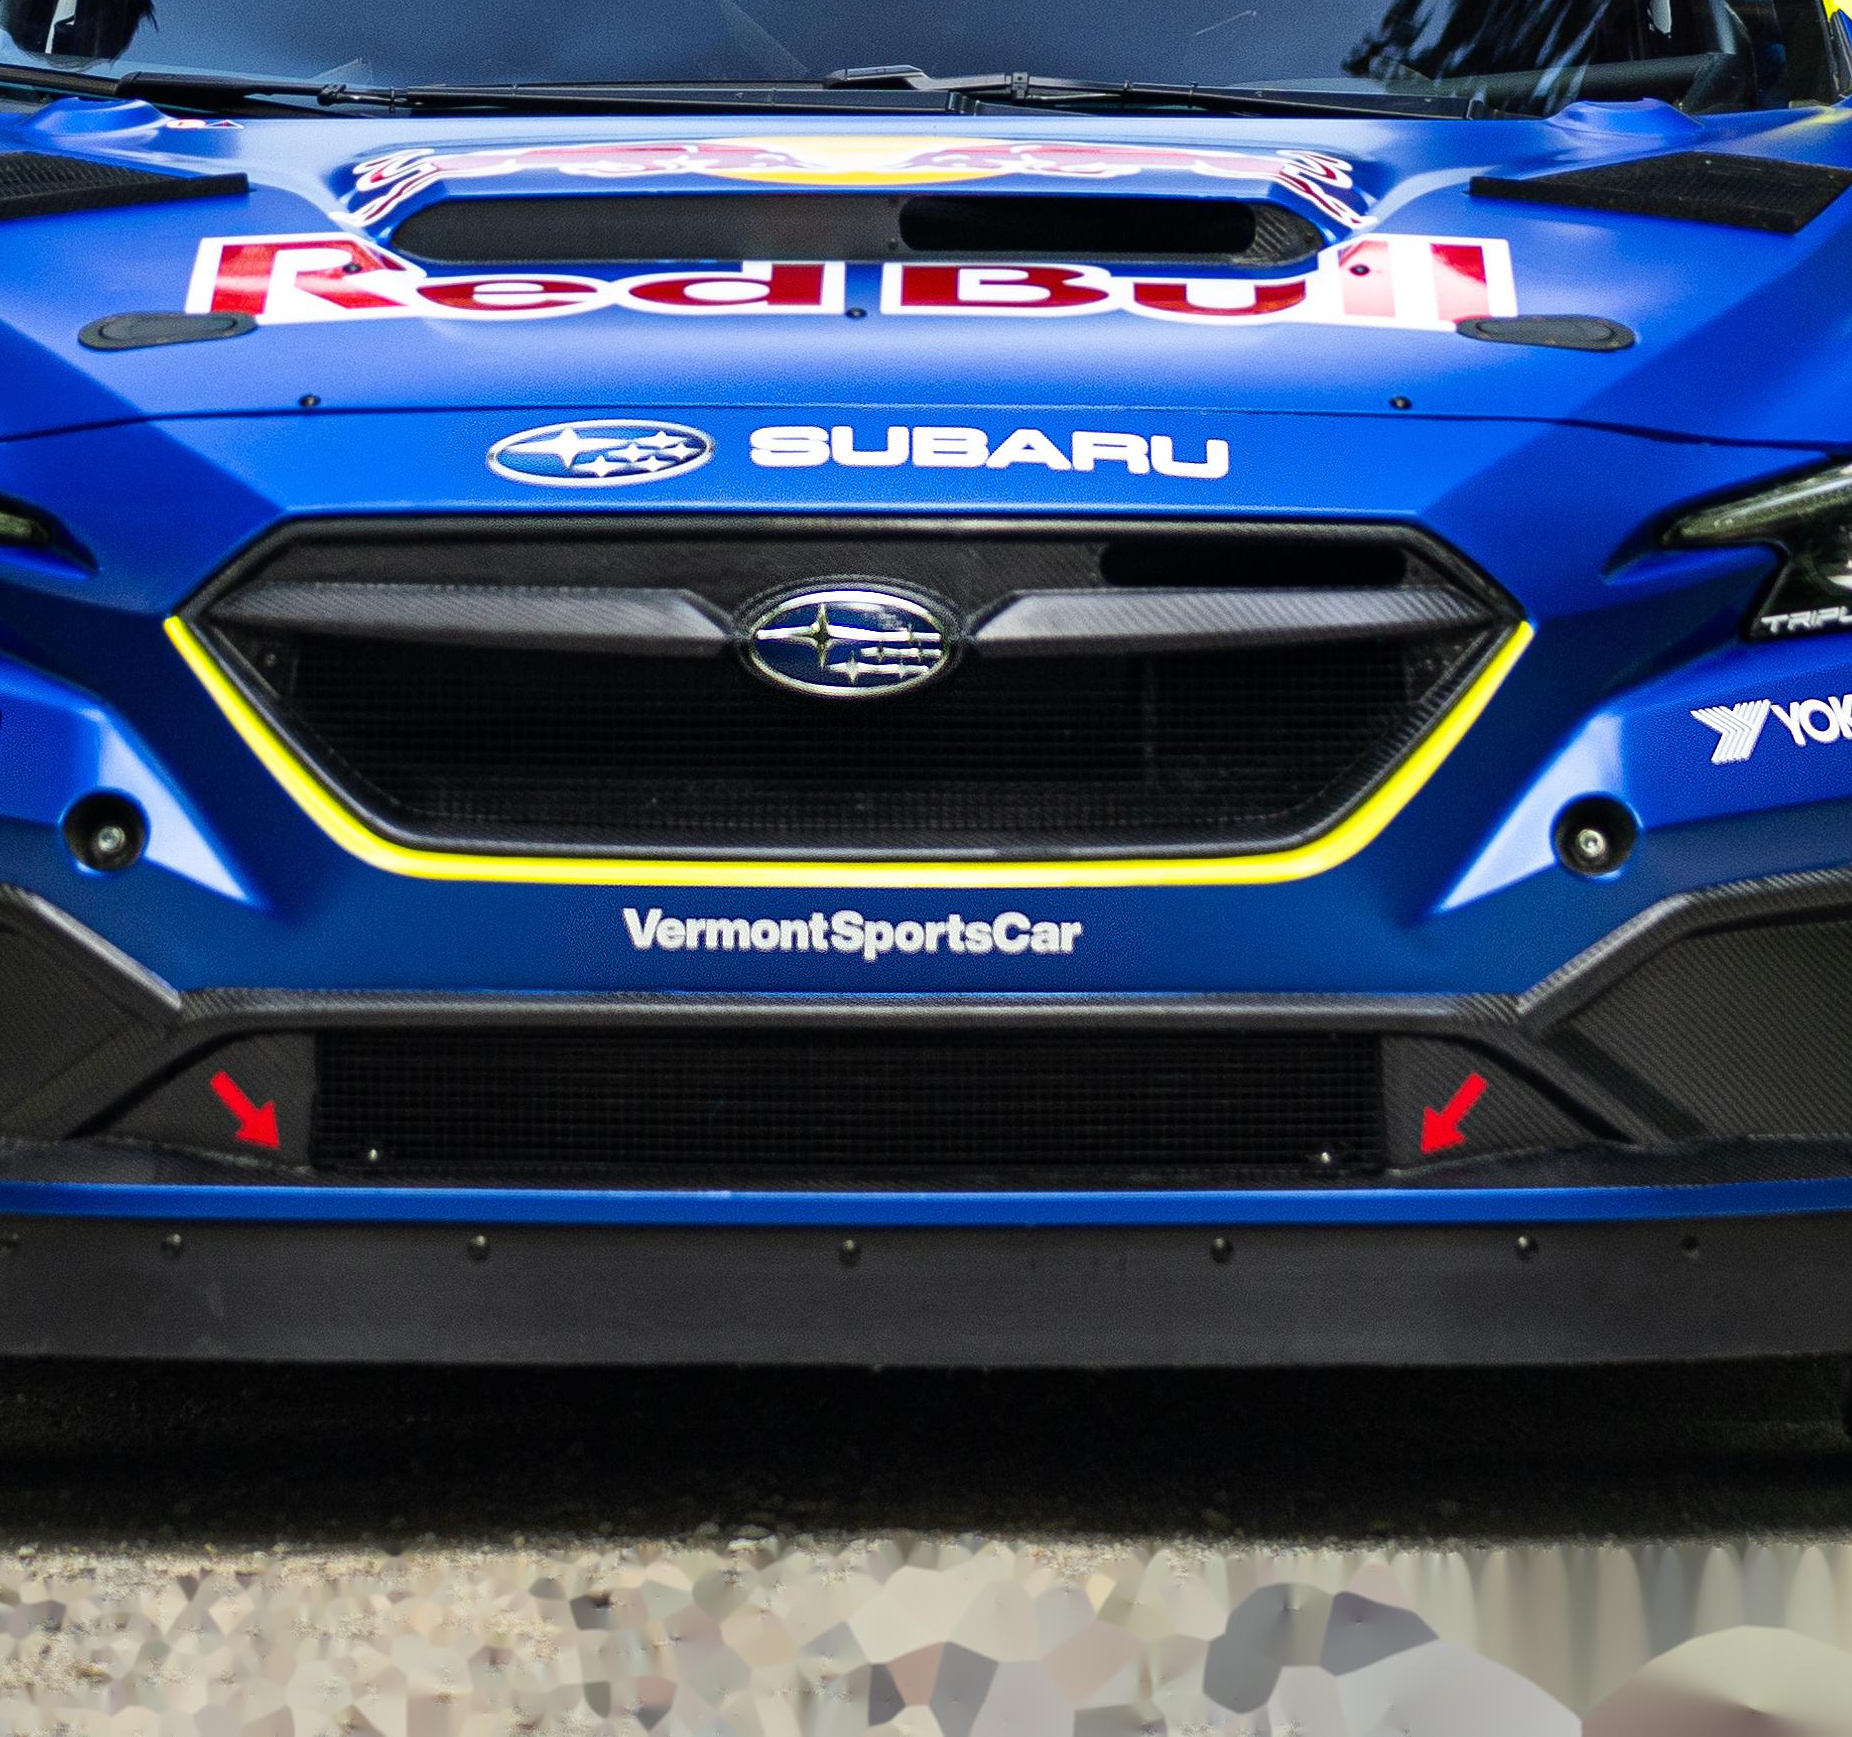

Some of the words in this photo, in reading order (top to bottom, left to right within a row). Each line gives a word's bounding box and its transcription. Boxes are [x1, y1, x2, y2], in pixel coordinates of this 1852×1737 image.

[199, 239, 831, 317] Red
[891, 237, 1515, 321] Bull
[750, 424, 1231, 480] SUBARU
[622, 906, 1084, 961] VermontSportsCar
